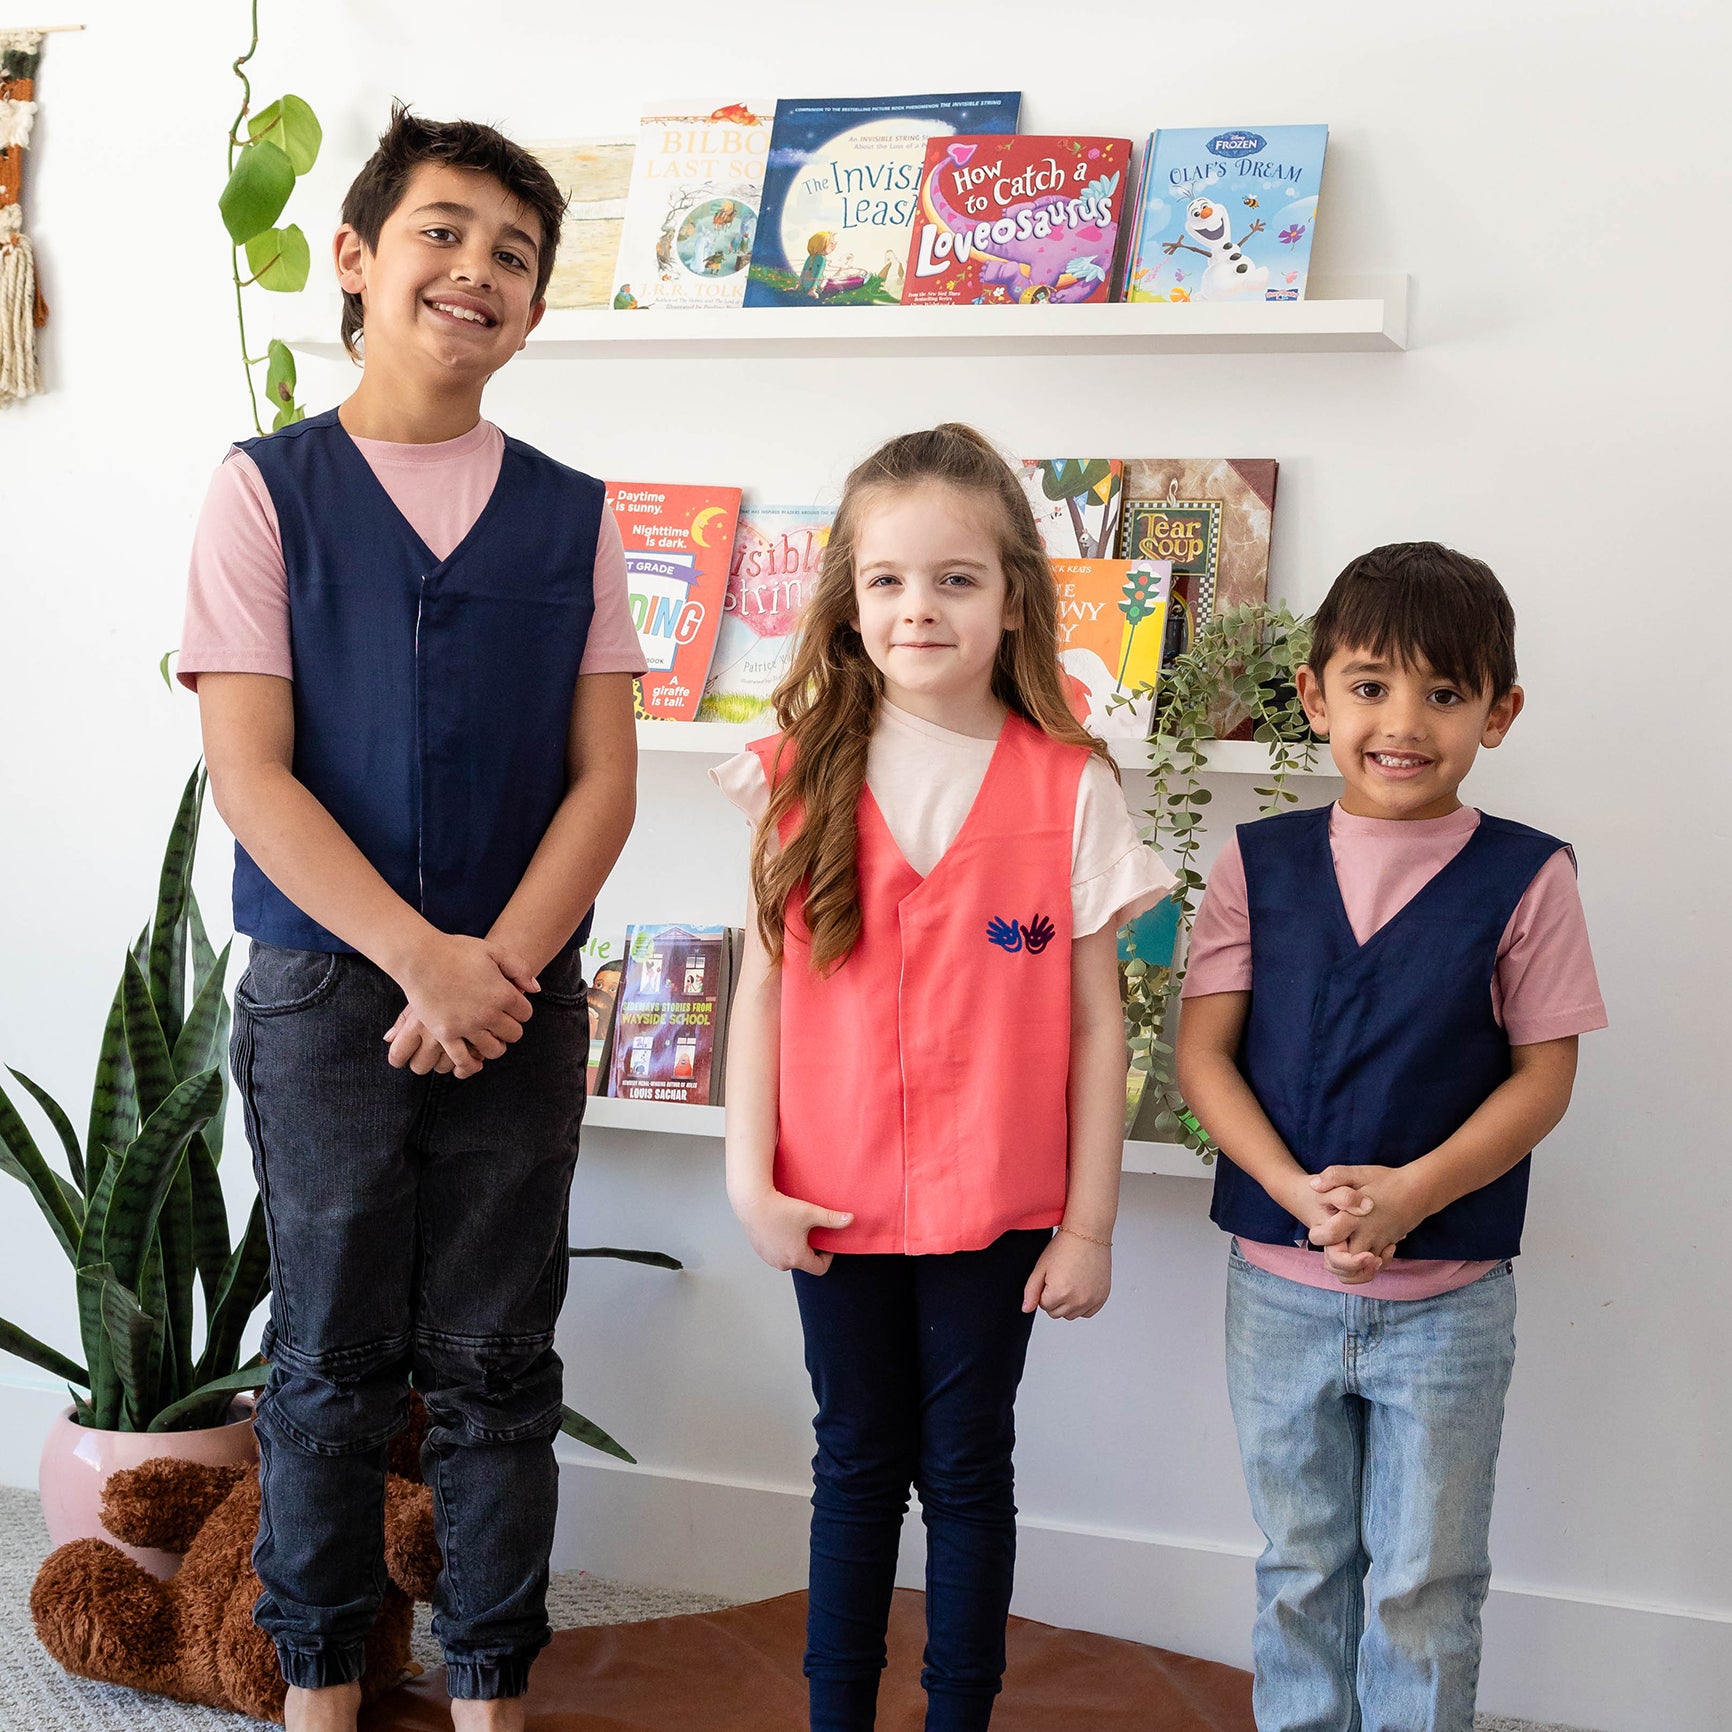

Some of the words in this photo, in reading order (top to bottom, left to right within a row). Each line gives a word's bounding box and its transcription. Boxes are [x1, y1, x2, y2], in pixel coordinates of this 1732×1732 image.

[659, 130, 771, 155] BILBO
[1215, 139, 1258, 151] FROZEN
[646, 159, 720, 179] LAST
[728, 159, 765, 179] SO
[1169, 161, 1227, 185] OLAF'S
[1235, 158, 1304, 183] DREAM
[952, 160, 1003, 195] How
[802, 176, 829, 195] The
[965, 194, 988, 214] to
[993, 157, 1066, 206] Catch
[1073, 162, 1088, 182] a
[915, 196, 1112, 279] Loveosaurus
[641, 283, 688, 297] J.R.R.
[695, 283, 745, 297] TOLK
[617, 489, 666, 503] Daytime
[615, 501, 626, 512] is
[627, 503, 663, 515] sunny.
[632, 524, 690, 537] Nighttime
[1136, 512, 1202, 540] Tear
[645, 536, 656, 547] is
[658, 537, 687, 549] dark.
[1138, 536, 1204, 563] Soup
[636, 561, 675, 575] GRADE
[1067, 565, 1092, 573] KEATS
[1060, 600, 1107, 621] WY
[629, 593, 706, 645] DING
[743, 659, 777, 673] Patrice
[669, 675, 679, 686] A
[652, 685, 690, 698] giraffe
[651, 696, 662, 706] is
[663, 697, 686, 708] tall.
[623, 1001, 660, 1012] SIDEWAYS
[662, 1002, 691, 1012] STORIES
[692, 1002, 713, 1012] FROM
[622, 1013, 668, 1025] WAYSIDE
[669, 1013, 711, 1025] SCHOOL
[629, 1087, 654, 1099] LOUIS
[654, 1088, 688, 1101] SACHAR
